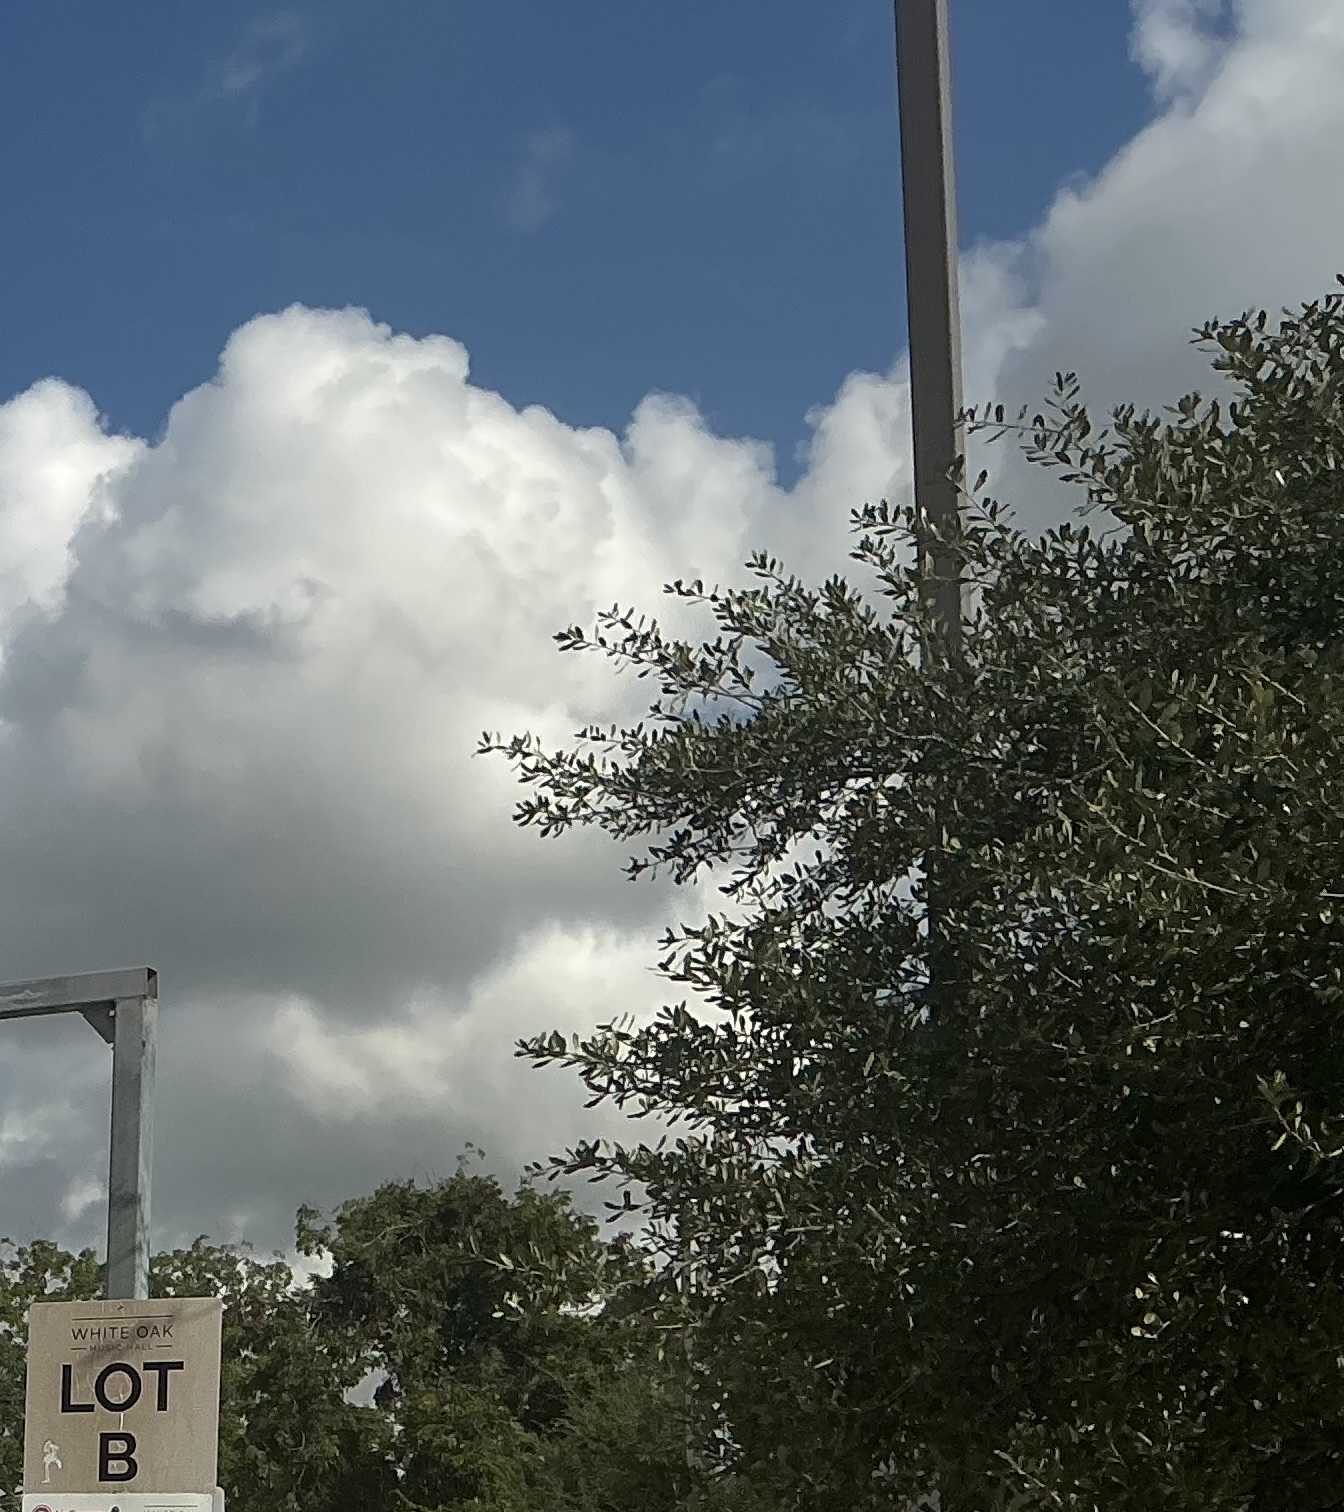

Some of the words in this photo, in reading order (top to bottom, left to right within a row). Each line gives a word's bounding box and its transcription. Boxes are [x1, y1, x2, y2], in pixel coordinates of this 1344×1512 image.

[72, 1326, 129, 1340] WHITE
[136, 1324, 174, 1338] OAK
[61, 1360, 184, 1413] LOT
[98, 1432, 139, 1482] B
